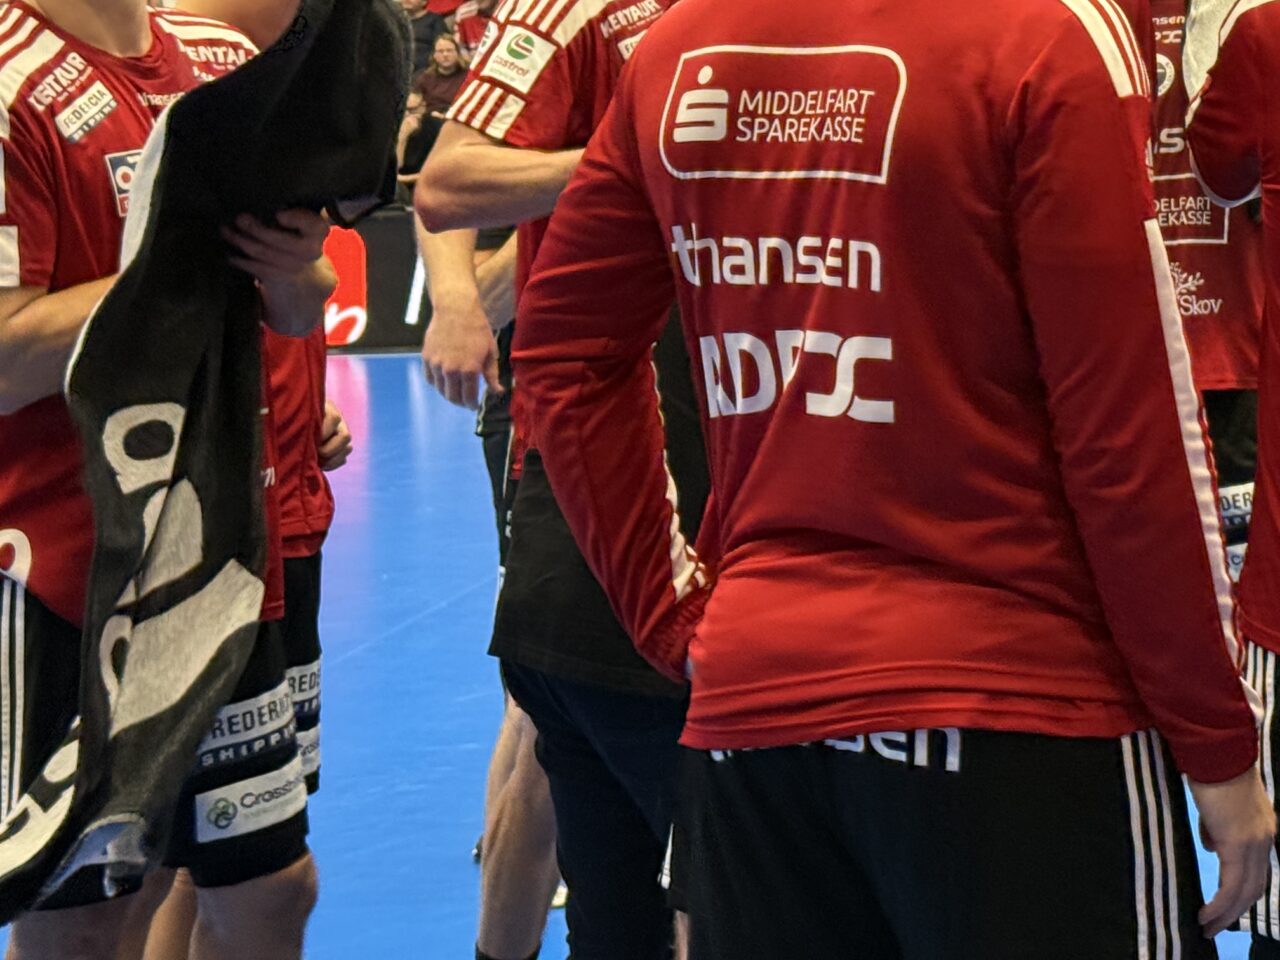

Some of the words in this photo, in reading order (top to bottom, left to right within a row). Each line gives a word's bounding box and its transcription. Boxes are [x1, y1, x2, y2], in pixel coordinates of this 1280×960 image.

[738, 88, 875, 116] MIDDELFART
[736, 116, 865, 143] SPAREKASSE
[671, 223, 881, 292] thansen
